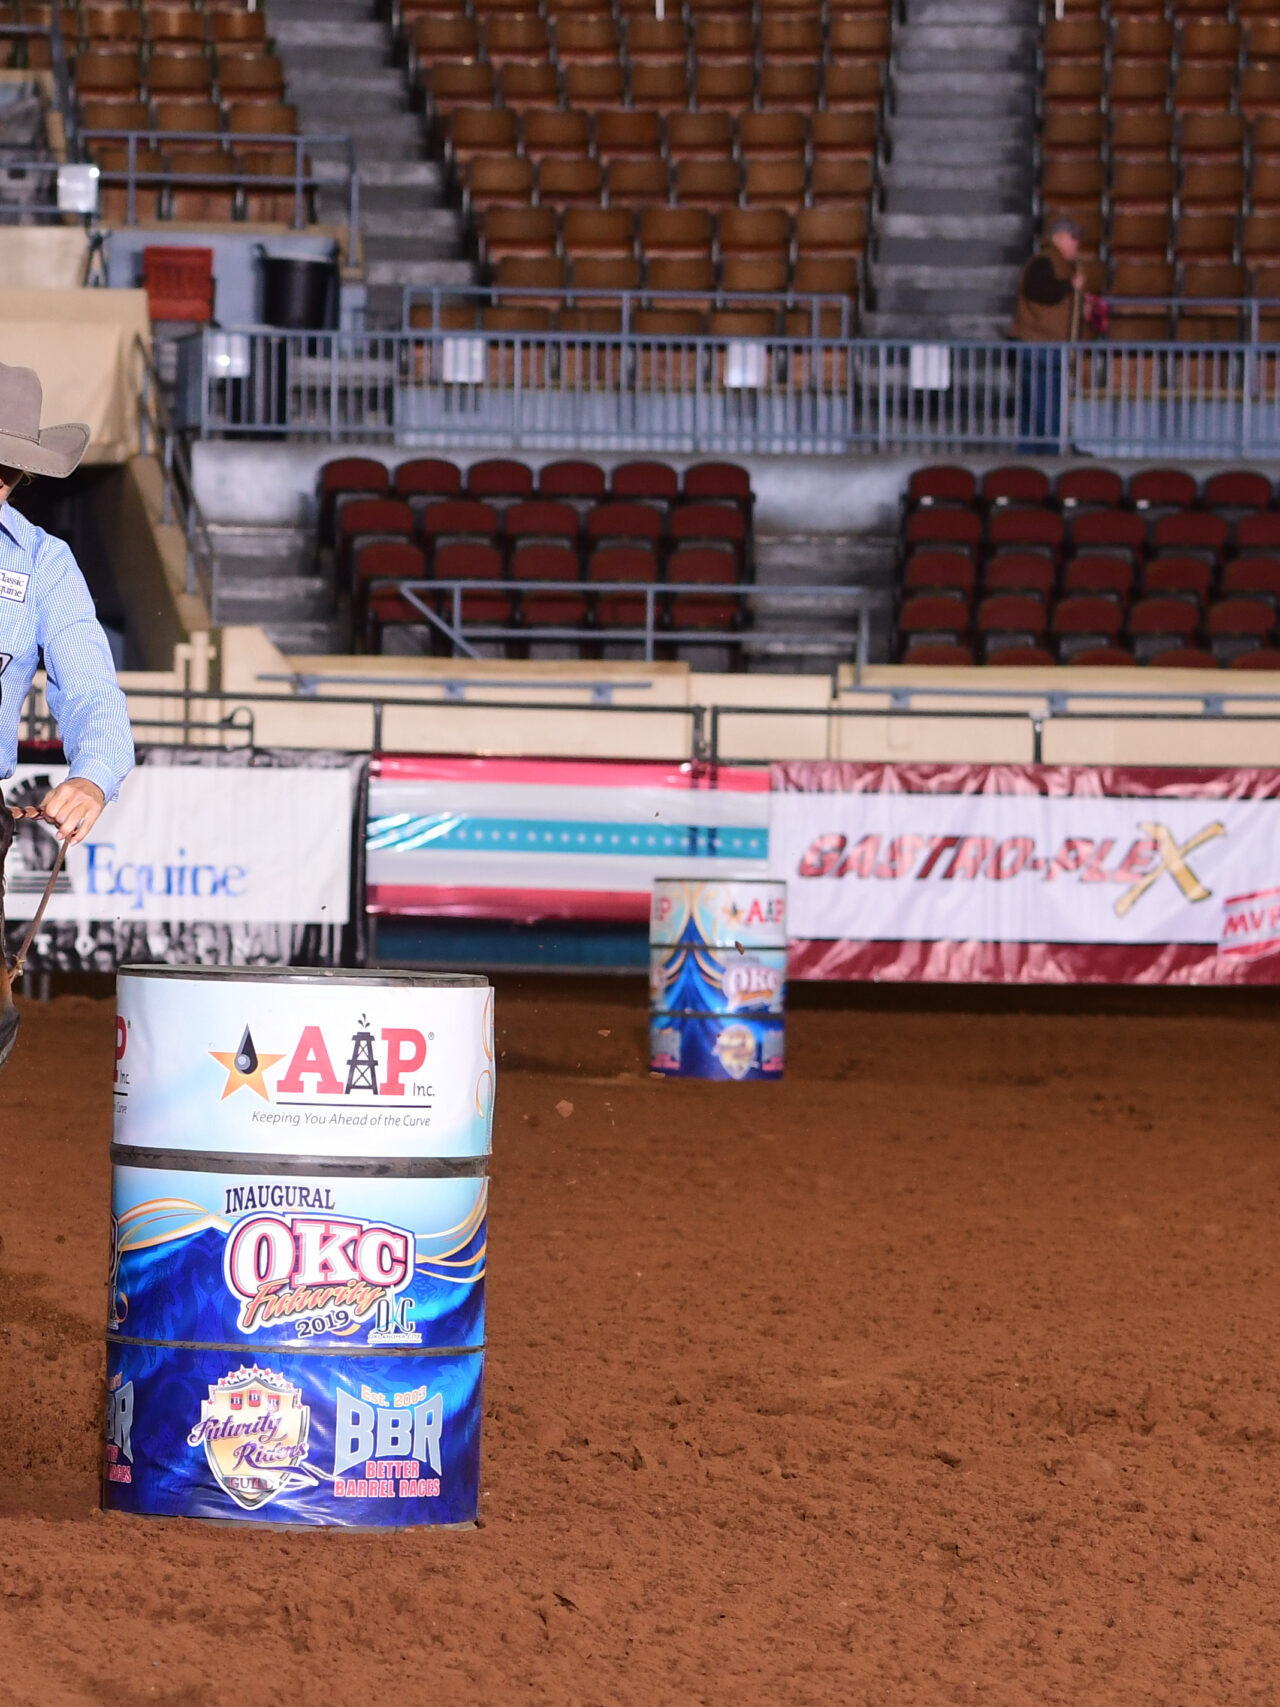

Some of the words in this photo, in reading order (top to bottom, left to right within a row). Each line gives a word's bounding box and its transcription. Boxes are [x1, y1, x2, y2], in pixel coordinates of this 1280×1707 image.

[81, 842, 248, 911] Equine
[412, 1081, 435, 1097] Inc.
[251, 1110, 300, 1126] Keeping
[304, 1112, 326, 1126] You
[329, 1113, 368, 1127] Ahead
[369, 1114, 383, 1127] of
[383, 1114, 401, 1127] the
[402, 1114, 431, 1127] Curve
[225, 1184, 336, 1215] INAUGURAL
[229, 1217, 408, 1299] OKC
[242, 1278, 386, 1328] Futurity
[296, 1310, 349, 1338] 2019
[361, 1384, 389, 1407] Est.
[190, 1411, 287, 1443] Futurity
[334, 1387, 443, 1476] BBR
[365, 1460, 420, 1479] BETTER
[333, 1479, 395, 1498] BARREL
[399, 1478, 441, 1498] RACES
